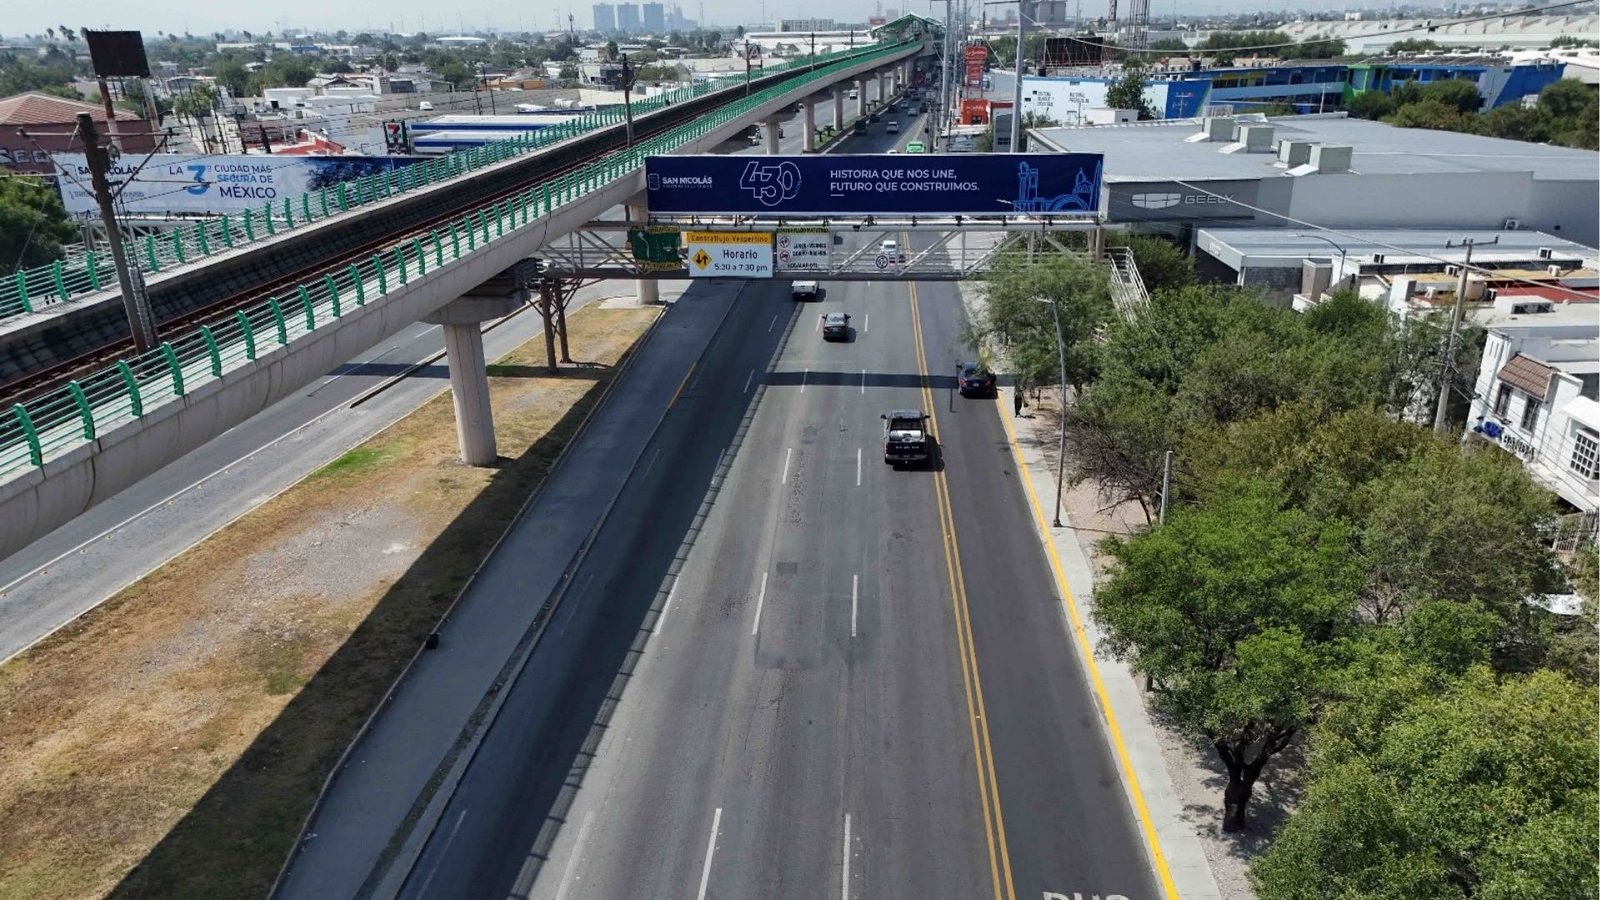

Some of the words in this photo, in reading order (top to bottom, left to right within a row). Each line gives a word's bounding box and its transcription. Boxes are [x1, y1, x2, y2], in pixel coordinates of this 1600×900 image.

[169, 166, 184, 175] LA
[214, 165, 249, 173] CIUDAD
[252, 165, 271, 174] MÁS
[830, 169, 879, 178] HISTORIA
[881, 169, 904, 180] QUE
[907, 169, 930, 178] NOS
[932, 169, 957, 180] UNE,
[217, 174, 256, 183] SEGURA
[260, 175, 273, 183] DE
[662, 176, 678, 184] SAN
[680, 175, 712, 184] NICOLÁS
[740, 161, 801, 206] 430
[220, 184, 276, 198] MÉXICO
[830, 182, 873, 191] FUTURO
[875, 182, 898, 192] QUE
[900, 182, 980, 191] CONSTRUIMOS.
[1185, 194, 1233, 204] GEELY
[691, 235, 729, 243] Contraflujo
[732, 235, 768, 243] Vespertino
[723, 249, 757, 259] Horario
